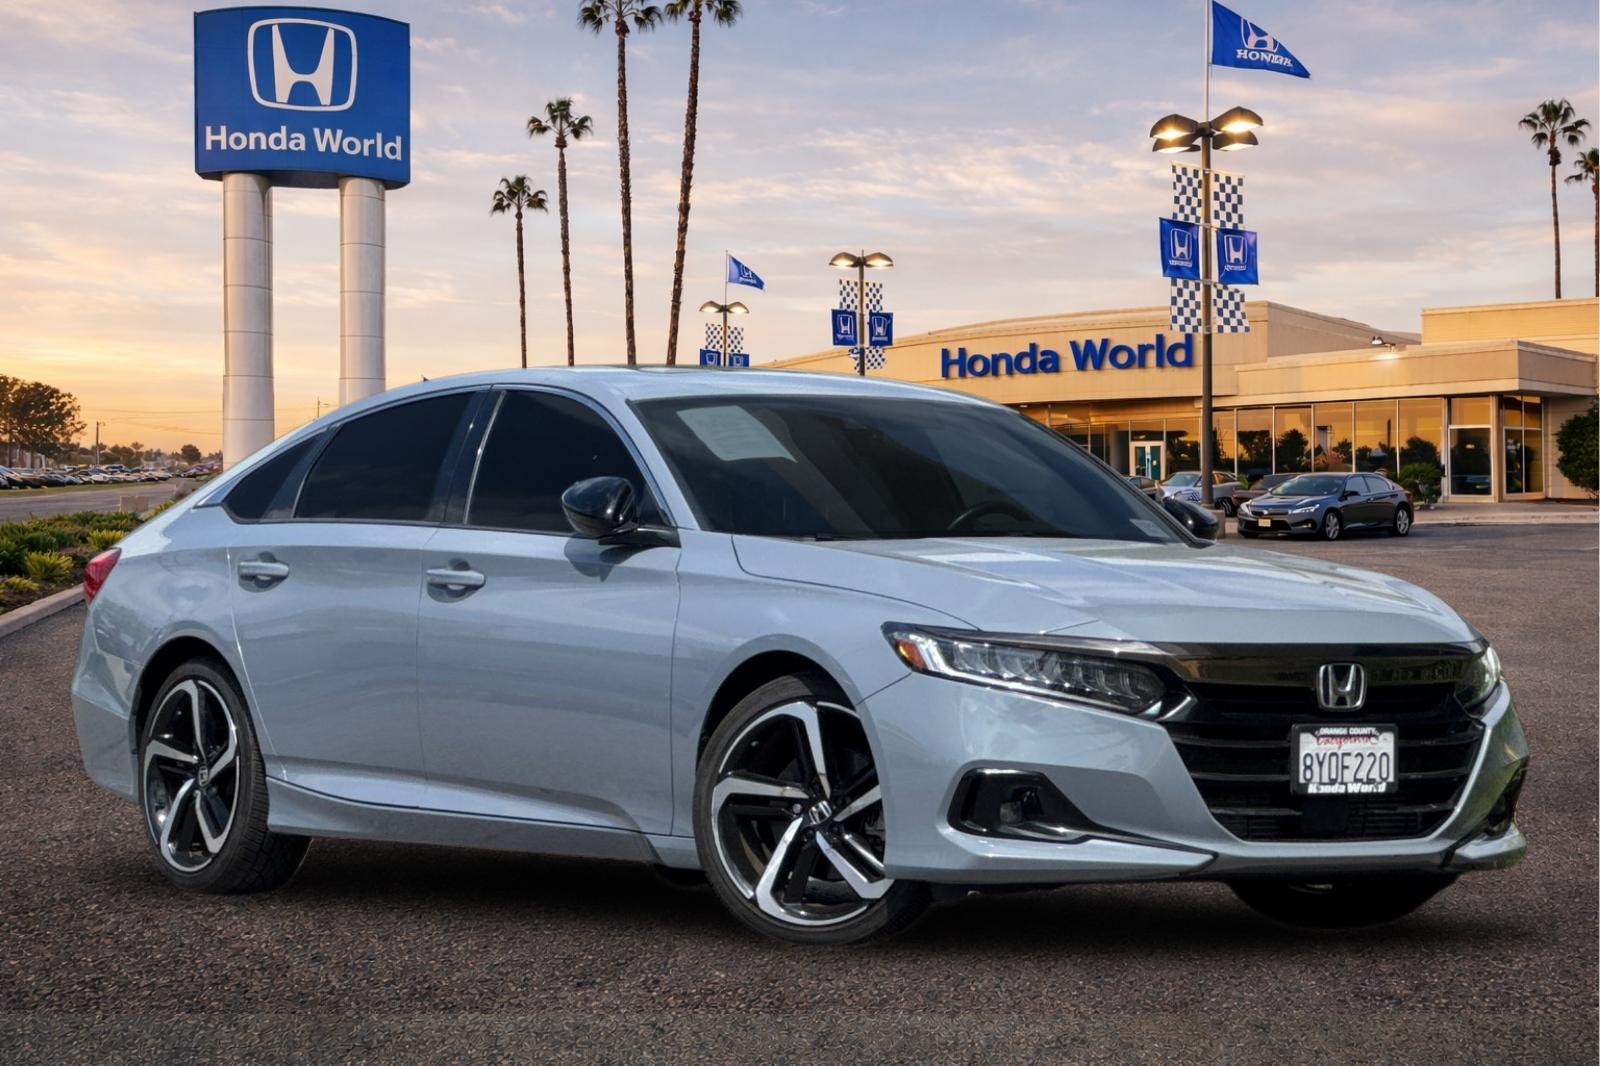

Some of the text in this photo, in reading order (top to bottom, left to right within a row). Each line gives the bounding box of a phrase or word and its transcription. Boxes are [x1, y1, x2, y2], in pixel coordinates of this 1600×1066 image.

[1236, 49, 1293, 67] HONDA
[205, 125, 402, 161] Honda World
[941, 333, 1194, 379] Honda World
[1349, 727, 1377, 735] COUNTY
